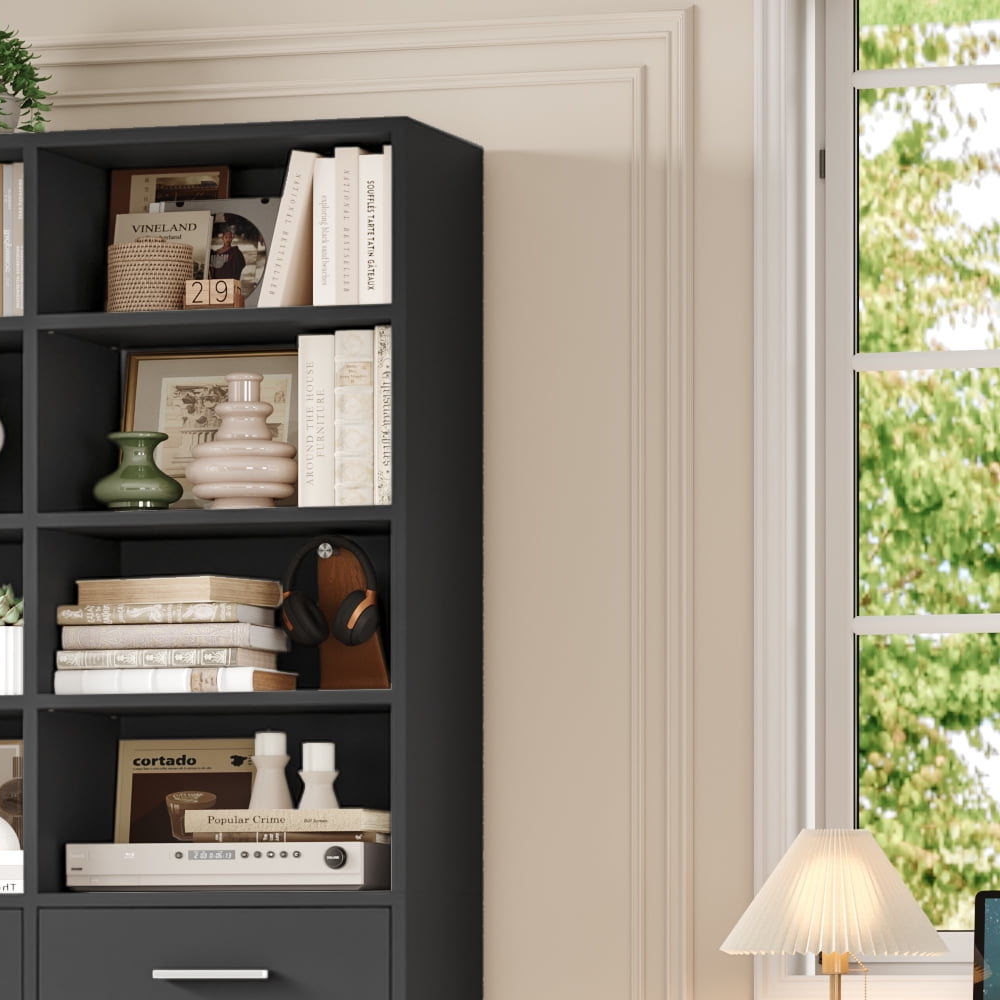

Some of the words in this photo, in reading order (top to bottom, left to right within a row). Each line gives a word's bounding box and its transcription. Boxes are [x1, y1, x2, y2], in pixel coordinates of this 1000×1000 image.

[318, 195, 329, 225] exploring
[132, 223, 197, 233] VINELAND
[367, 215, 375, 235] TARTE
[305, 361, 314, 401] HOUSE
[305, 406, 314, 431] THE
[317, 388, 325, 457] FURNITURE
[305, 435, 314, 486] AROUND
[133, 755, 197, 766] cortado
[208, 815, 249, 826] Popular
[252, 815, 286, 824] Crime
